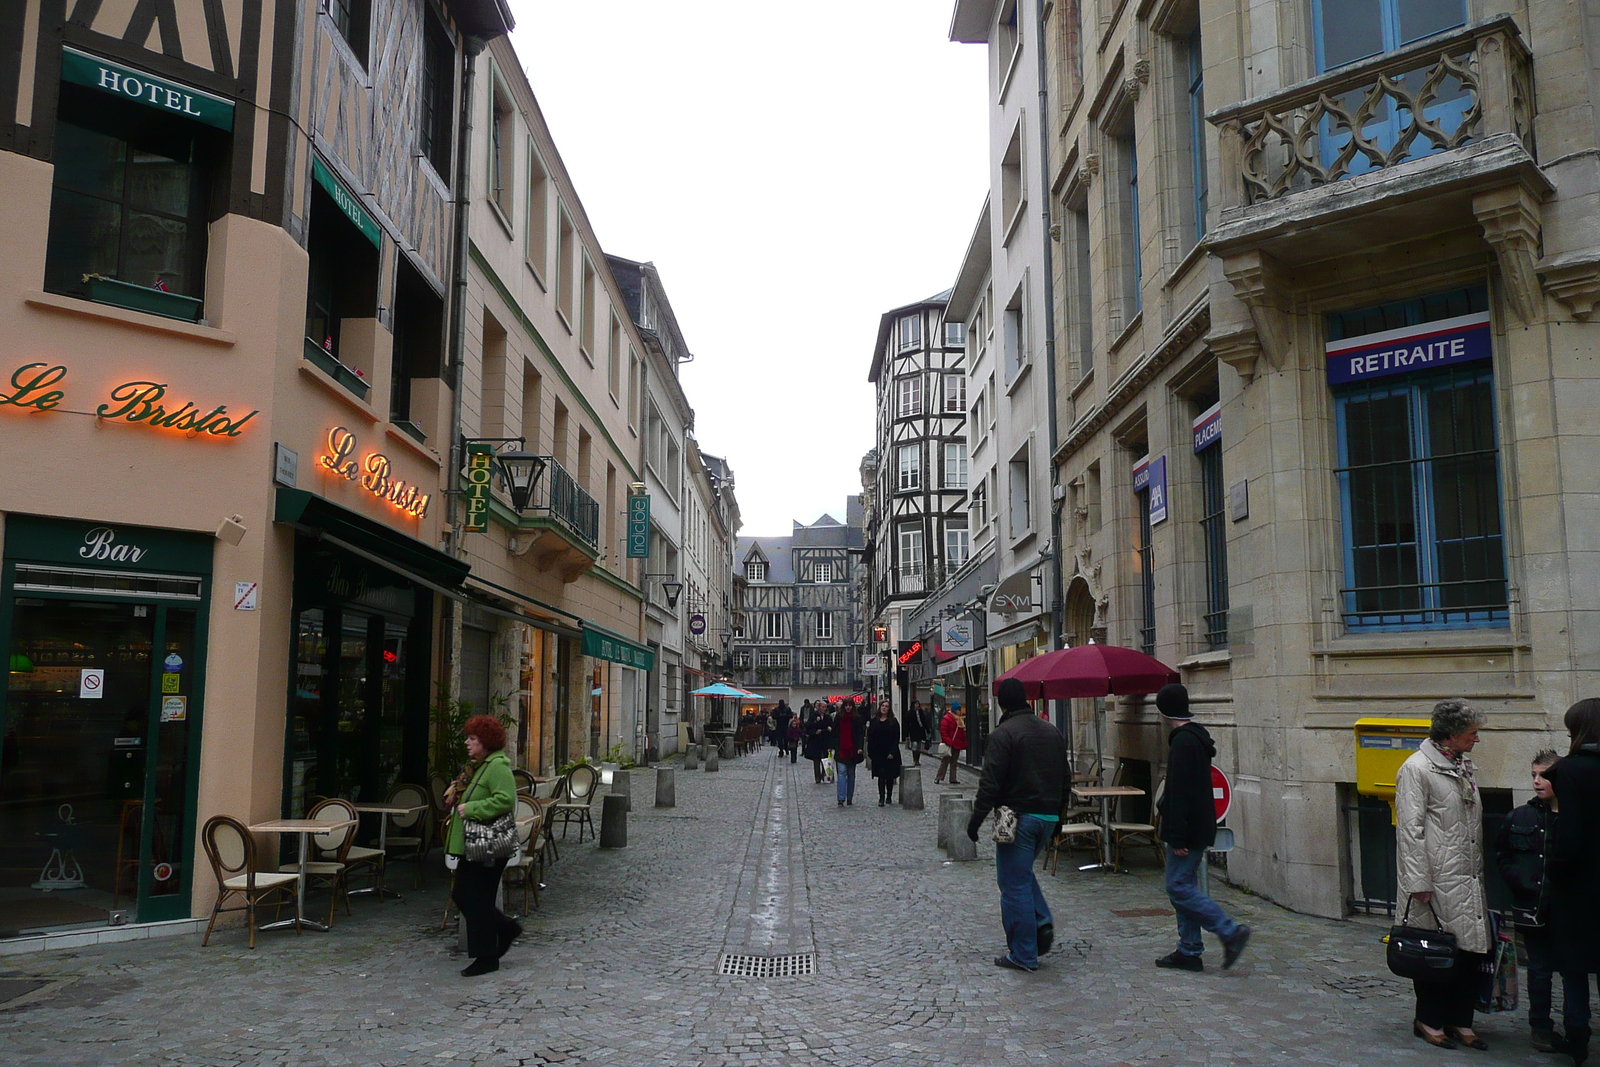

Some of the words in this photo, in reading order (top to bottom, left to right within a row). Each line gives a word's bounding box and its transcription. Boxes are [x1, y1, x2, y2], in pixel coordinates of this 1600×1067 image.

[97, 66, 202, 119] HOTEL
[333, 183, 365, 230] HOTEL
[1349, 337, 1466, 376] RETRAITE
[0, 362, 68, 411] Le
[96, 380, 260, 438] Bristol
[320, 426, 360, 482] Le
[361, 452, 431, 519] Bristol
[468, 455, 491, 529] HOTEL
[1149, 484, 1163, 511] AXA
[79, 527, 149, 563] Bar
[631, 500, 646, 556] indicible
[898, 641, 922, 665] DEALER
